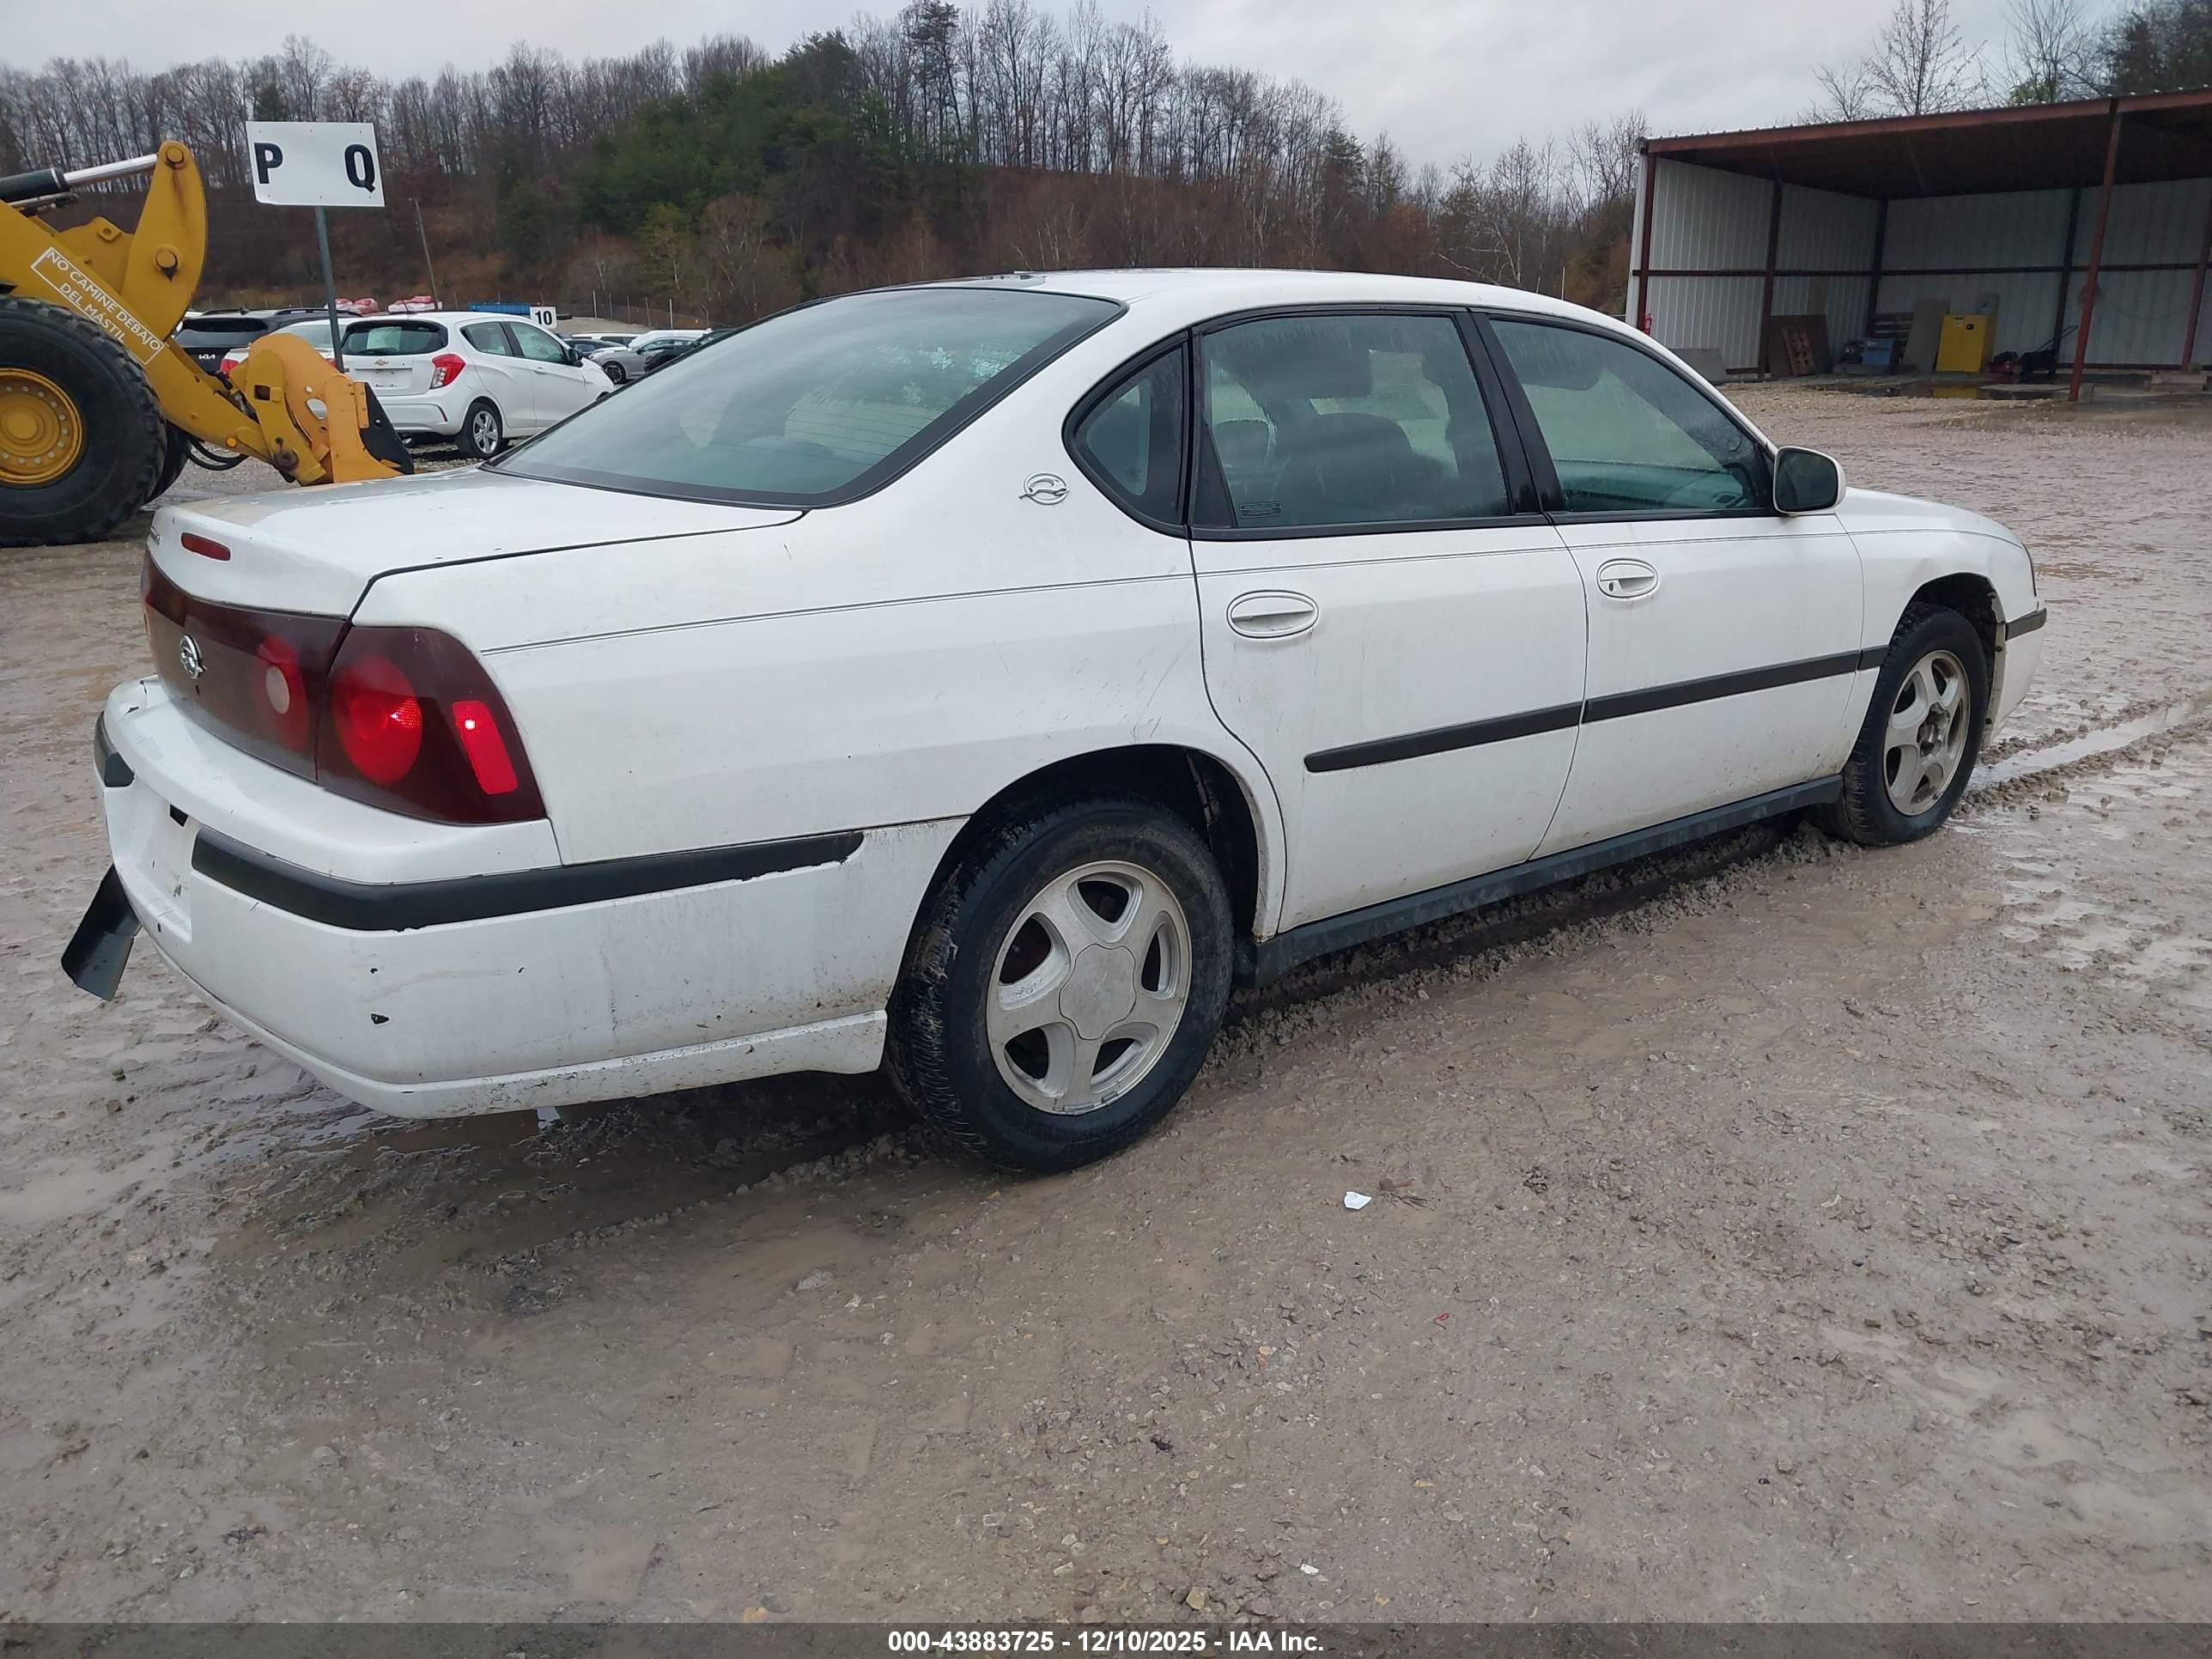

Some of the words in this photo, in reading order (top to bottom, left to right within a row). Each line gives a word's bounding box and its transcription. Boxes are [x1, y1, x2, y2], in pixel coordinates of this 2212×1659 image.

[254, 143, 283, 185] P
[344, 144, 375, 192] Q
[47, 251, 69, 270] NO
[70, 271, 118, 313] CAMINE
[116, 311, 161, 350] DEBAJO
[60, 283, 83, 306] DEL
[535, 310, 553, 325] 10
